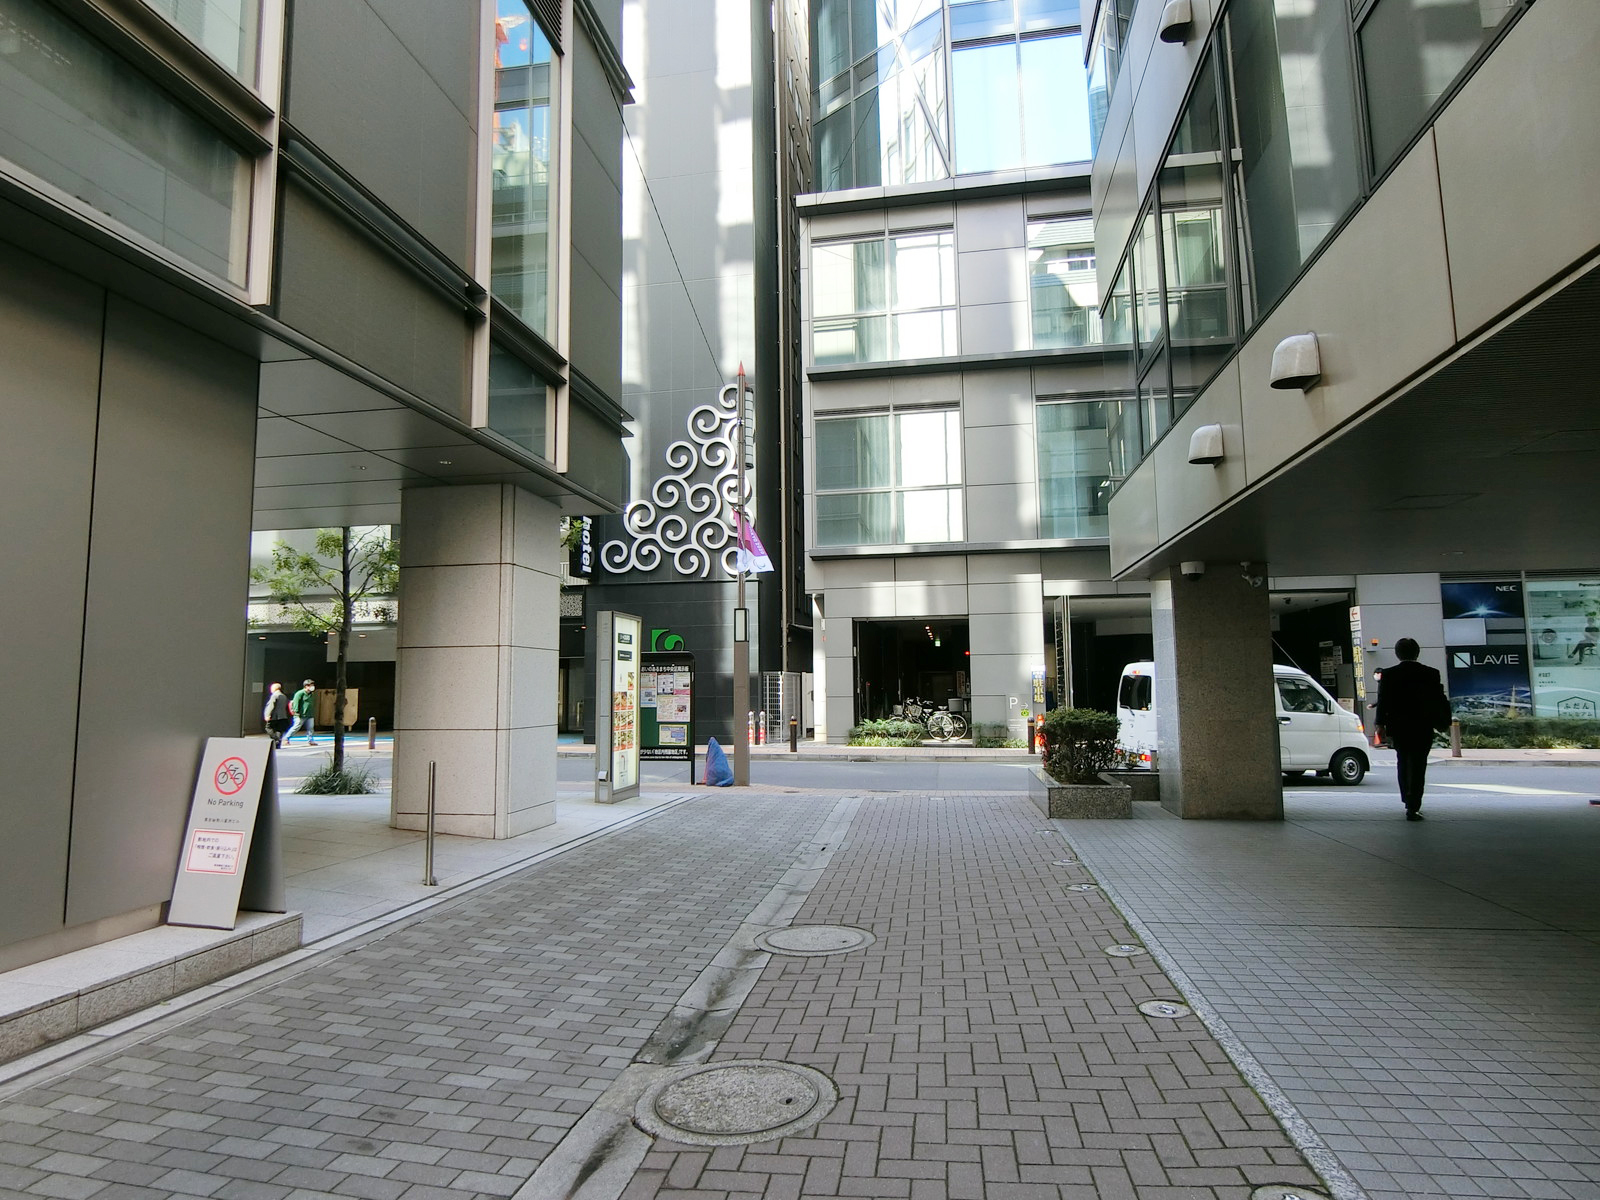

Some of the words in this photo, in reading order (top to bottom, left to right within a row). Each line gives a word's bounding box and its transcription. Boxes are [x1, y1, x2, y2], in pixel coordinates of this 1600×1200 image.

[582, 515, 593, 573] hotel
[1472, 654, 1520, 665] LAVIE
[1009, 697, 1018, 710] P
[1563, 702, 1590, 710] ふだん
[218, 798, 244, 808] Parking
